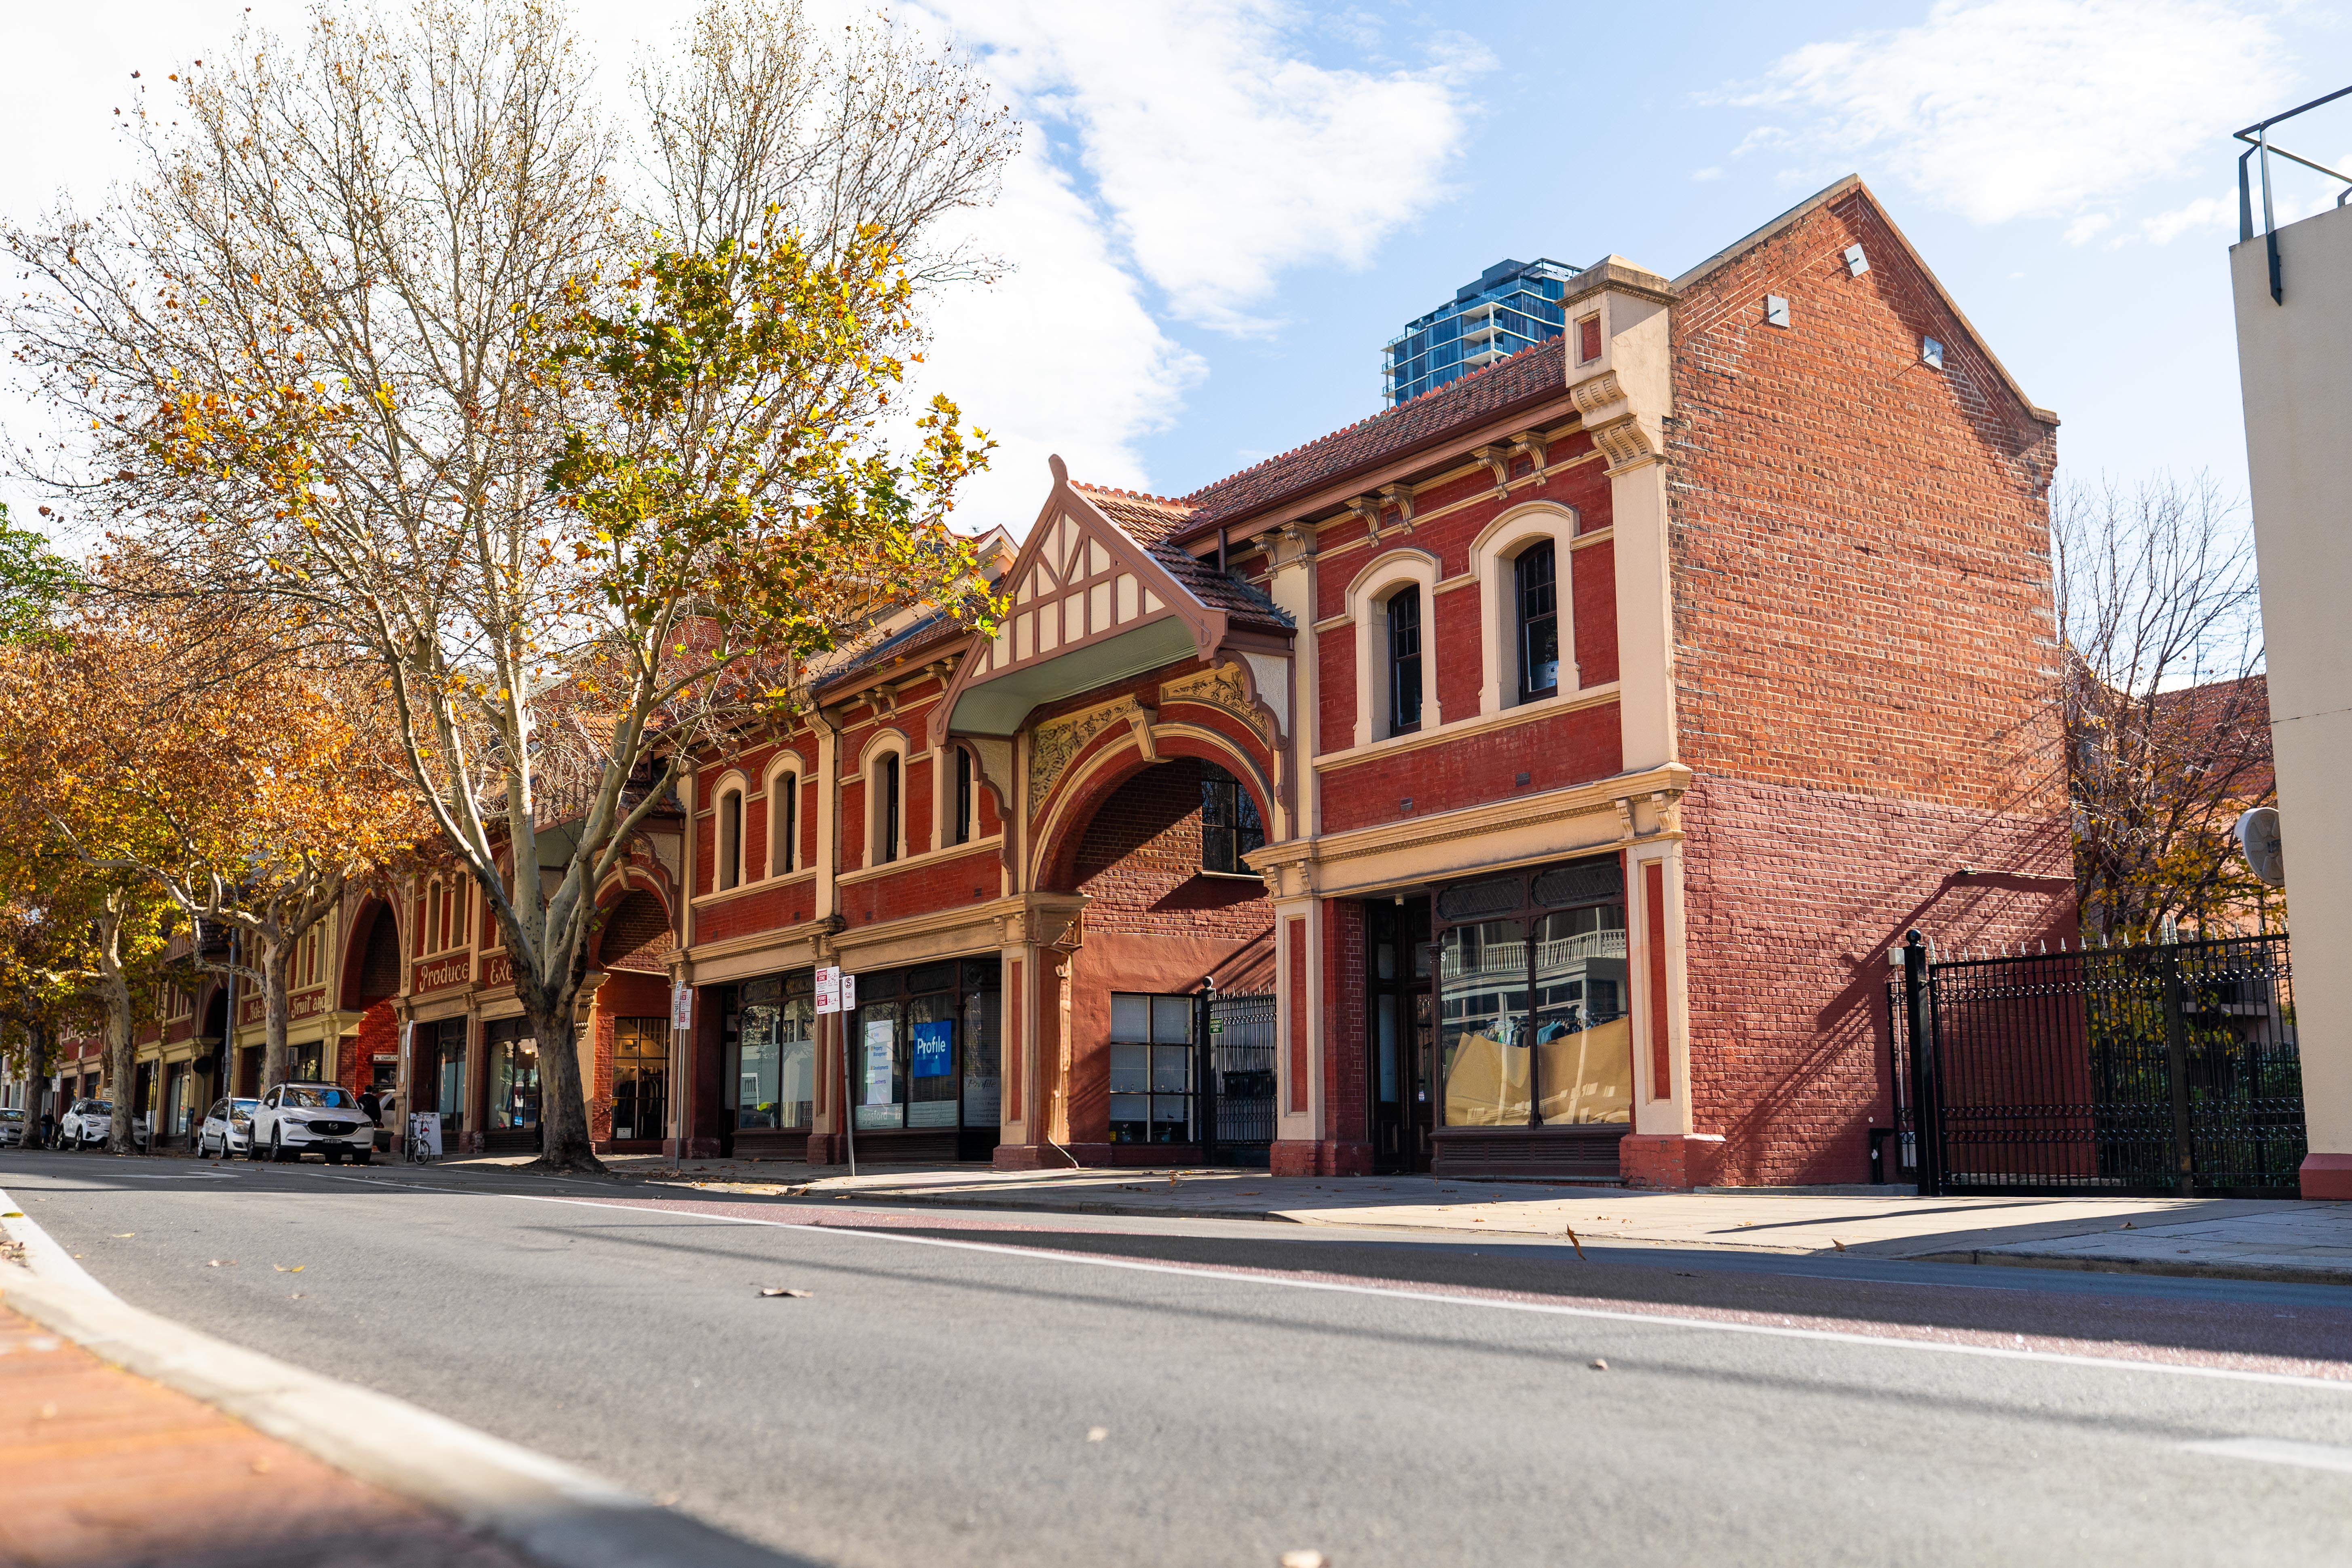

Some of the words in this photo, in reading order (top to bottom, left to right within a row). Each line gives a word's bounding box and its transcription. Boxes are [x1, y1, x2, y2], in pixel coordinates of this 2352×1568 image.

[419, 961, 469, 992] Produce
[291, 994, 311, 1019] Fruit
[917, 1035, 946, 1054] Profile
